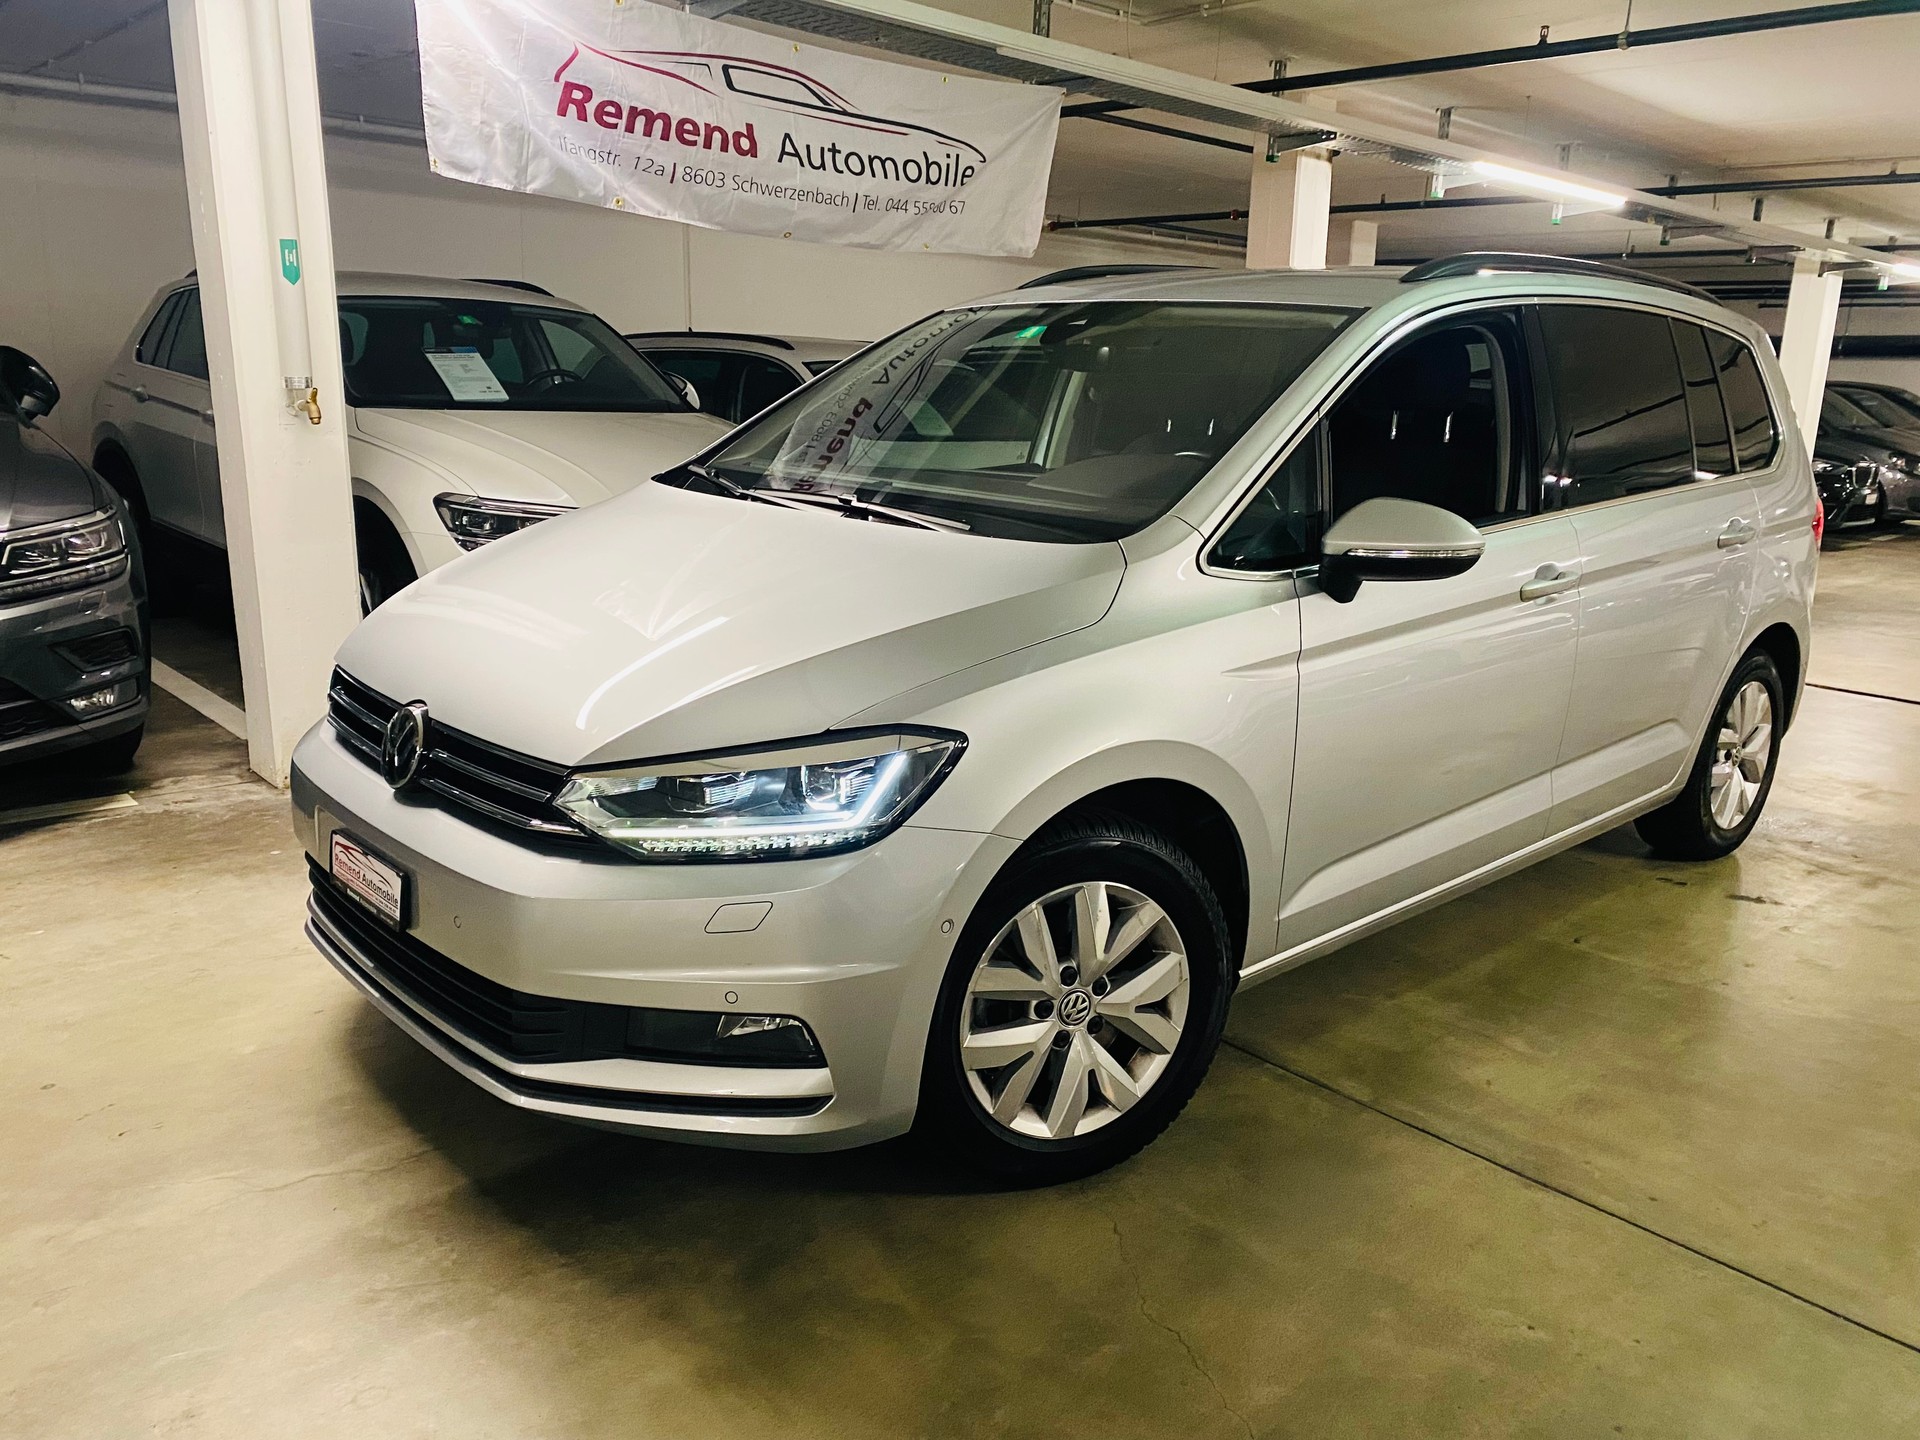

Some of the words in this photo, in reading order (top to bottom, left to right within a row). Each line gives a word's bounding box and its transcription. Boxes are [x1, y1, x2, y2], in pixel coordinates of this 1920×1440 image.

[556, 80, 758, 159] Remend
[777, 132, 976, 188] Automobile
[634, 156, 665, 177] 12a
[682, 166, 726, 188] 8603
[731, 174, 850, 207] Schwerzenbach
[862, 194, 880, 212] Tel.
[885, 197, 909, 213] 044
[949, 200, 966, 215] 67
[362, 873, 399, 907] Automobile
